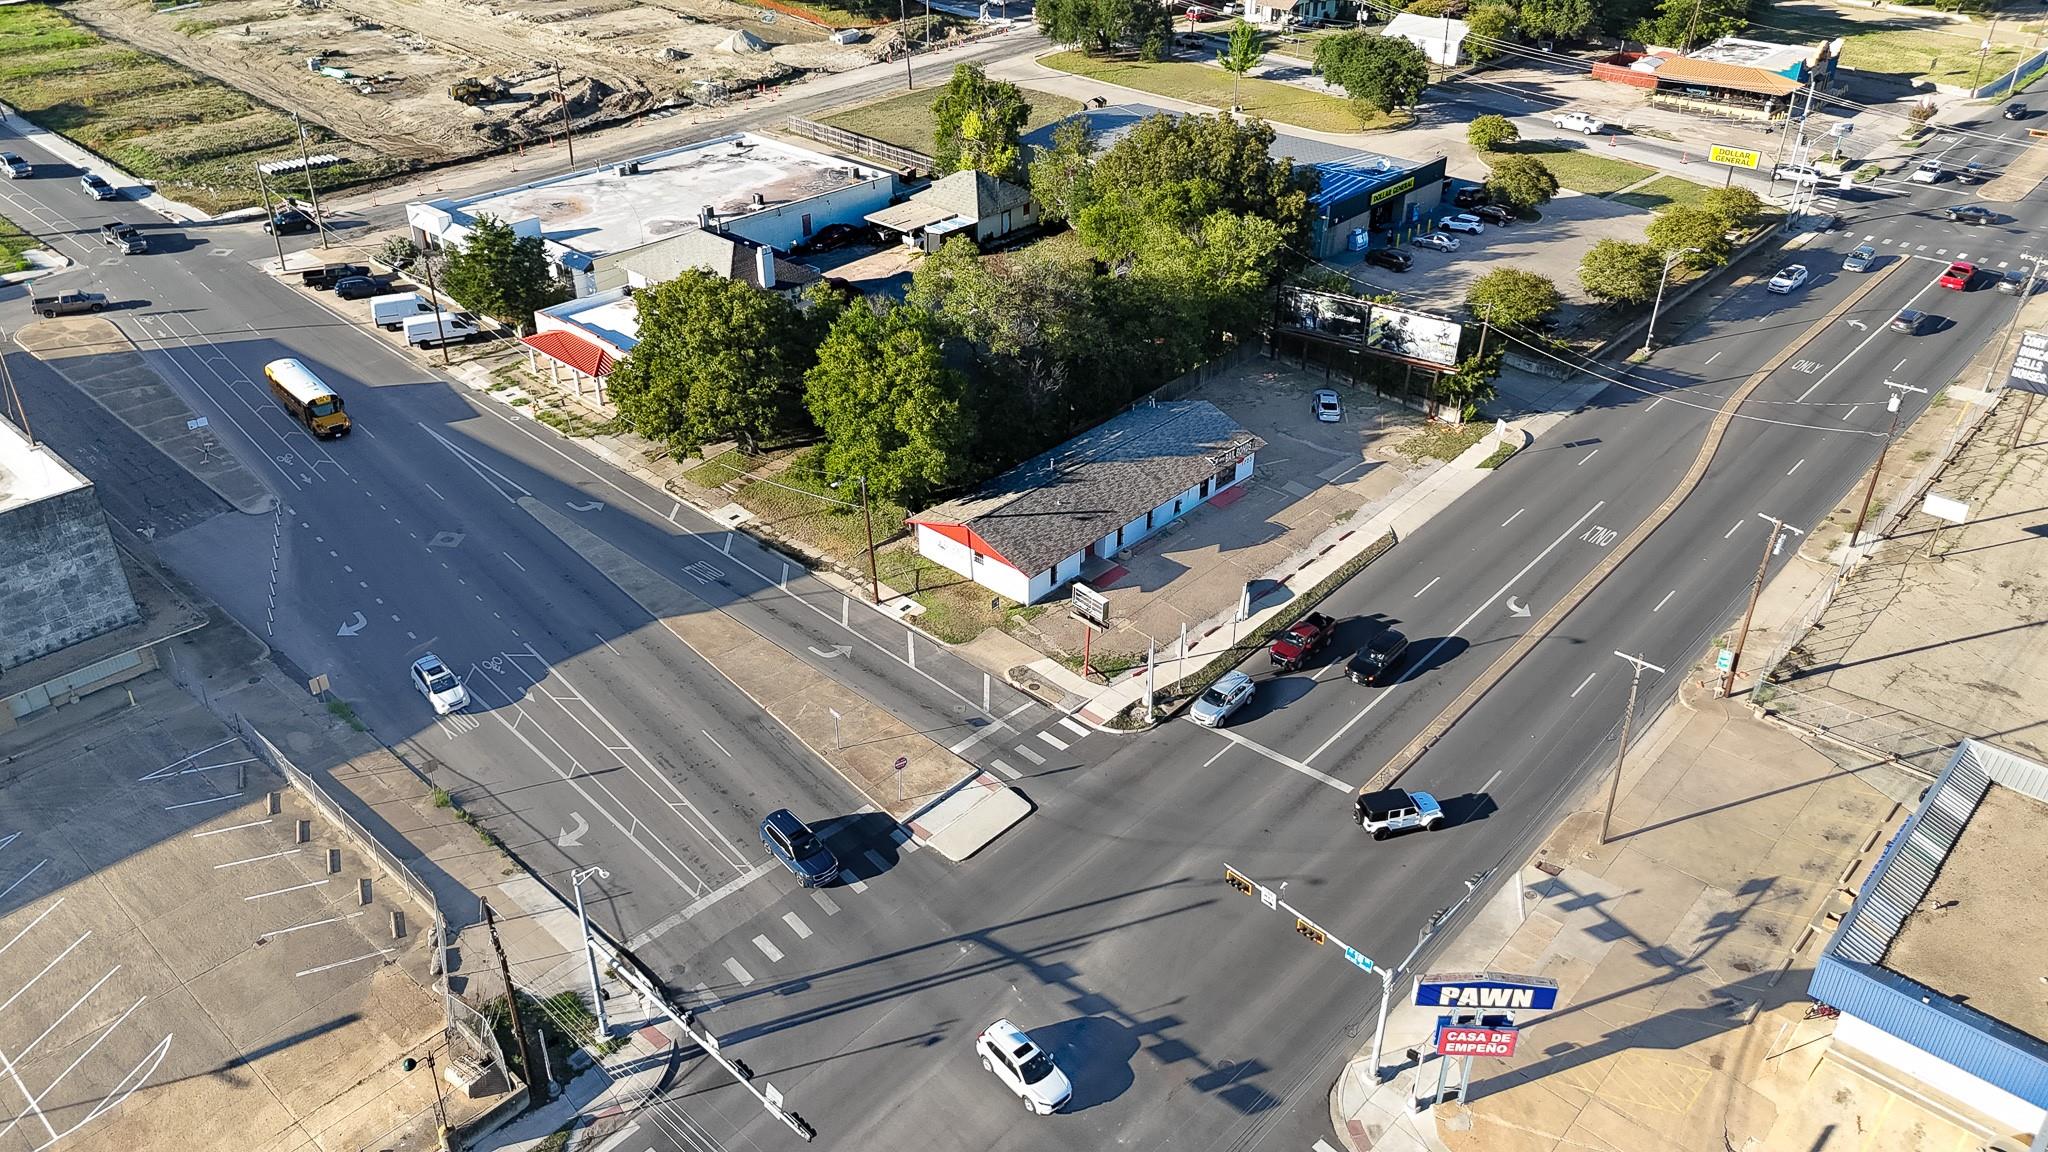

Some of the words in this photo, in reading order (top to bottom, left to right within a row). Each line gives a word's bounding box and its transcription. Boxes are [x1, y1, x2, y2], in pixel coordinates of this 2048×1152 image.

[1715, 154, 1751, 167] GENERAL
[1719, 148, 1751, 160] DOLLAR
[1373, 190, 1392, 202] DOLLAR
[1792, 359, 1824, 375] ONLY
[2014, 357, 2044, 371] SELLS
[1579, 525, 1618, 547] ONLY
[681, 560, 726, 584] ONLY
[1439, 986, 1535, 1008] PAWN
[1446, 1031, 1486, 1043] CASA
[1491, 1033, 1511, 1043] DE
[1445, 1043, 1508, 1054] EMPEÑO
